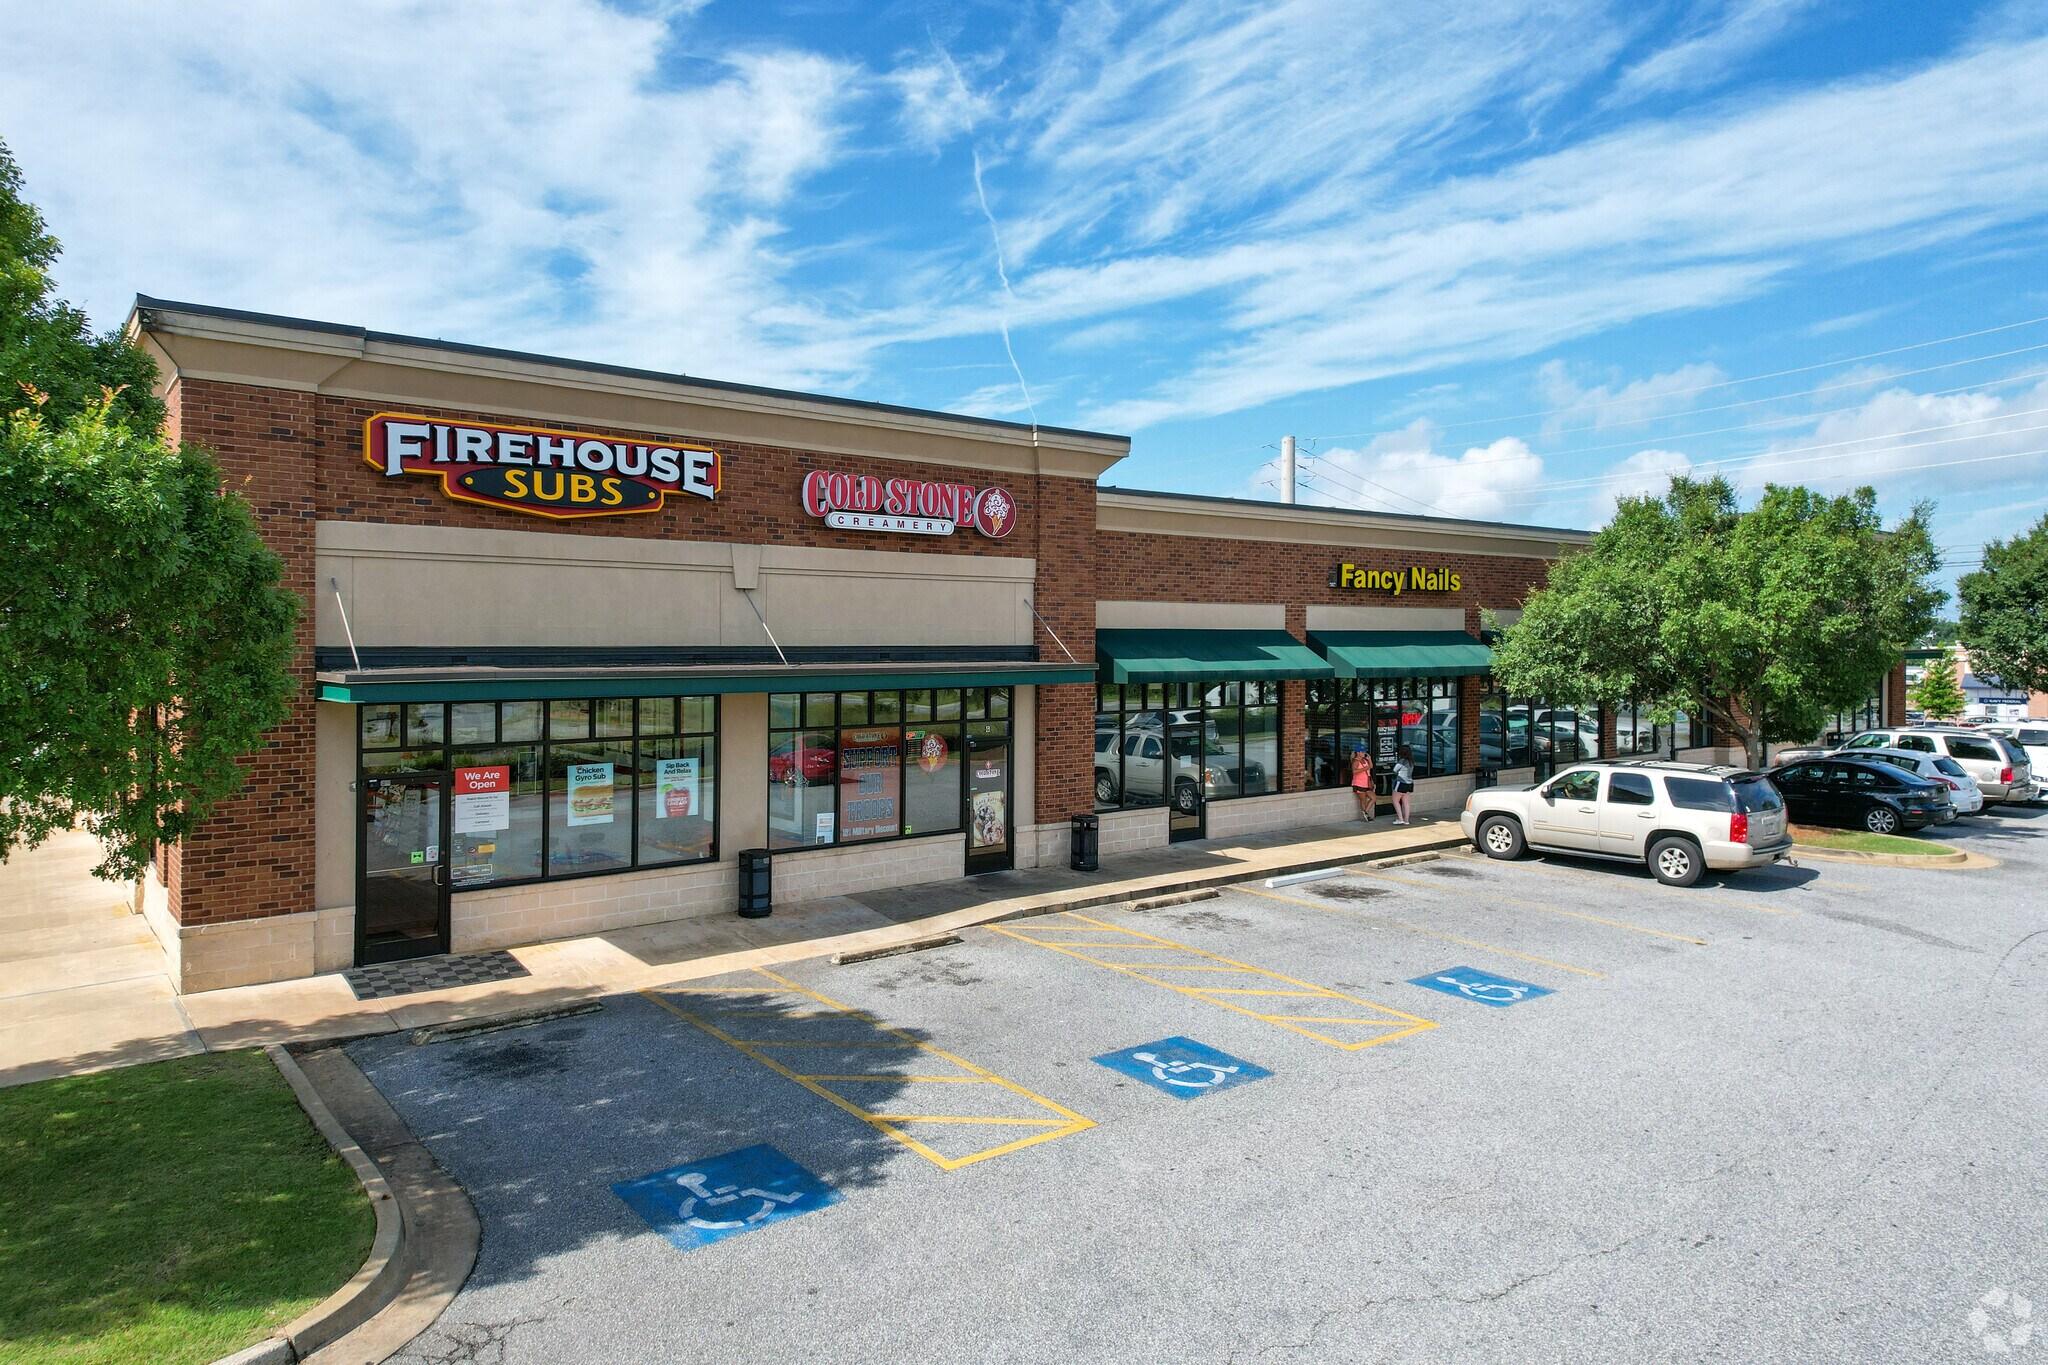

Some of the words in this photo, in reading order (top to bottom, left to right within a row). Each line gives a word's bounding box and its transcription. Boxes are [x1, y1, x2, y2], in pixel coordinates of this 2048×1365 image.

[384, 421, 715, 500] FIREHOUSE
[503, 468, 624, 506] SUBS
[803, 470, 884, 517] COLD
[885, 478, 976, 528] STONE
[836, 515, 948, 532] CREAMERY
[1340, 563, 1405, 596] Fancy
[1411, 566, 1461, 592] Nails
[1402, 712, 1421, 726] OPEN
[665, 762, 675, 770] Sip
[843, 745, 898, 771] SUPPORT
[464, 772, 481, 780] We
[482, 771, 500, 780] Are
[575, 774, 592, 782] Gyro
[576, 766, 605, 774] Chicken
[469, 780, 496, 790] Open
[859, 772, 883, 795] OUR
[847, 797, 894, 822] TROOPS
[852, 825, 874, 836] Military
[875, 823, 898, 834] Discount
